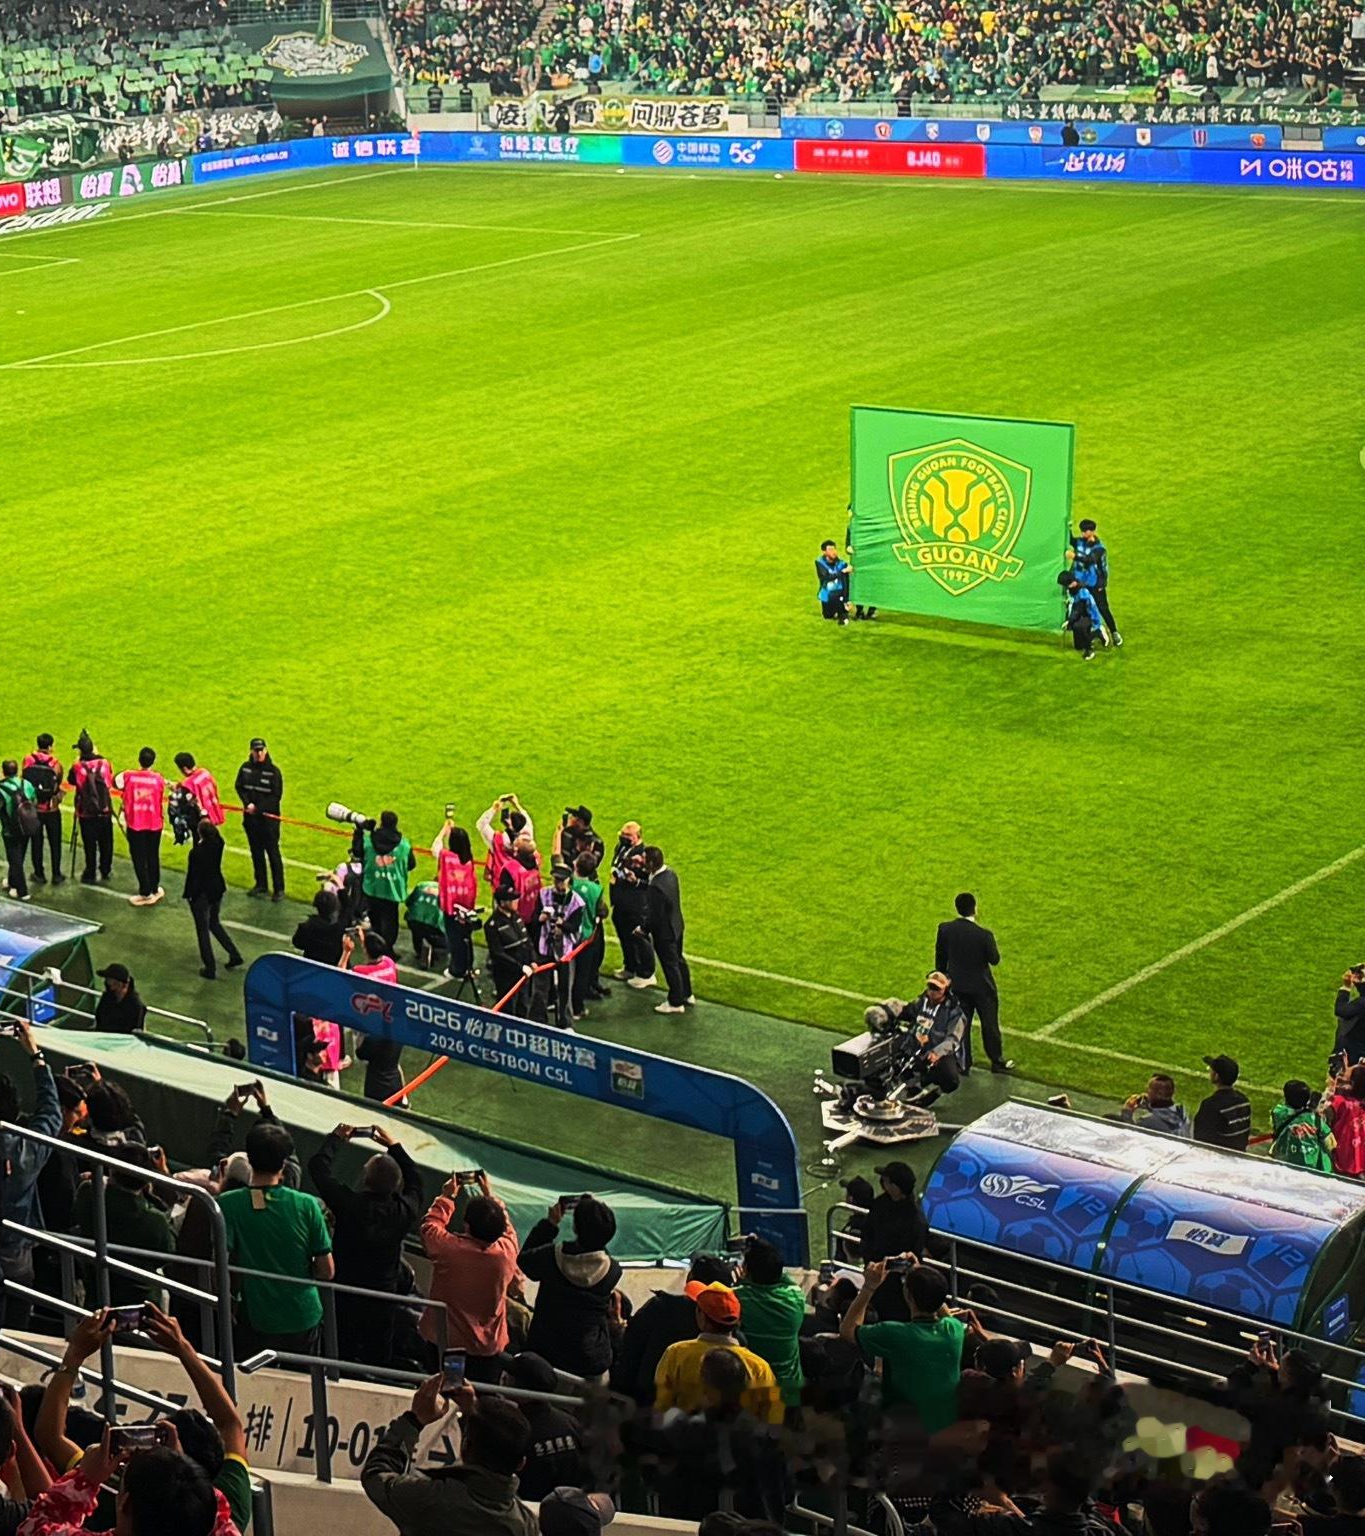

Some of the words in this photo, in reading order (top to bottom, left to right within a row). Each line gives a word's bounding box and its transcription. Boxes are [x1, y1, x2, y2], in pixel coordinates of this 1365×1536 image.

[25, 178, 62, 208] 联想
[917, 457, 956, 481] GUOAN
[960, 458, 1004, 504] FOOTBALL
[995, 507, 1008, 538] CLUB
[917, 546, 998, 574] GUOAN
[942, 569, 970, 584] 1992
[405, 999, 461, 1031] 2026
[506, 1027, 597, 1070] 中超联赛
[430, 1032, 465, 1054] 2026
[468, 1042, 541, 1076] C'ESTBON
[545, 1065, 573, 1085] CSL
[1015, 1194, 1047, 1211] CSL
